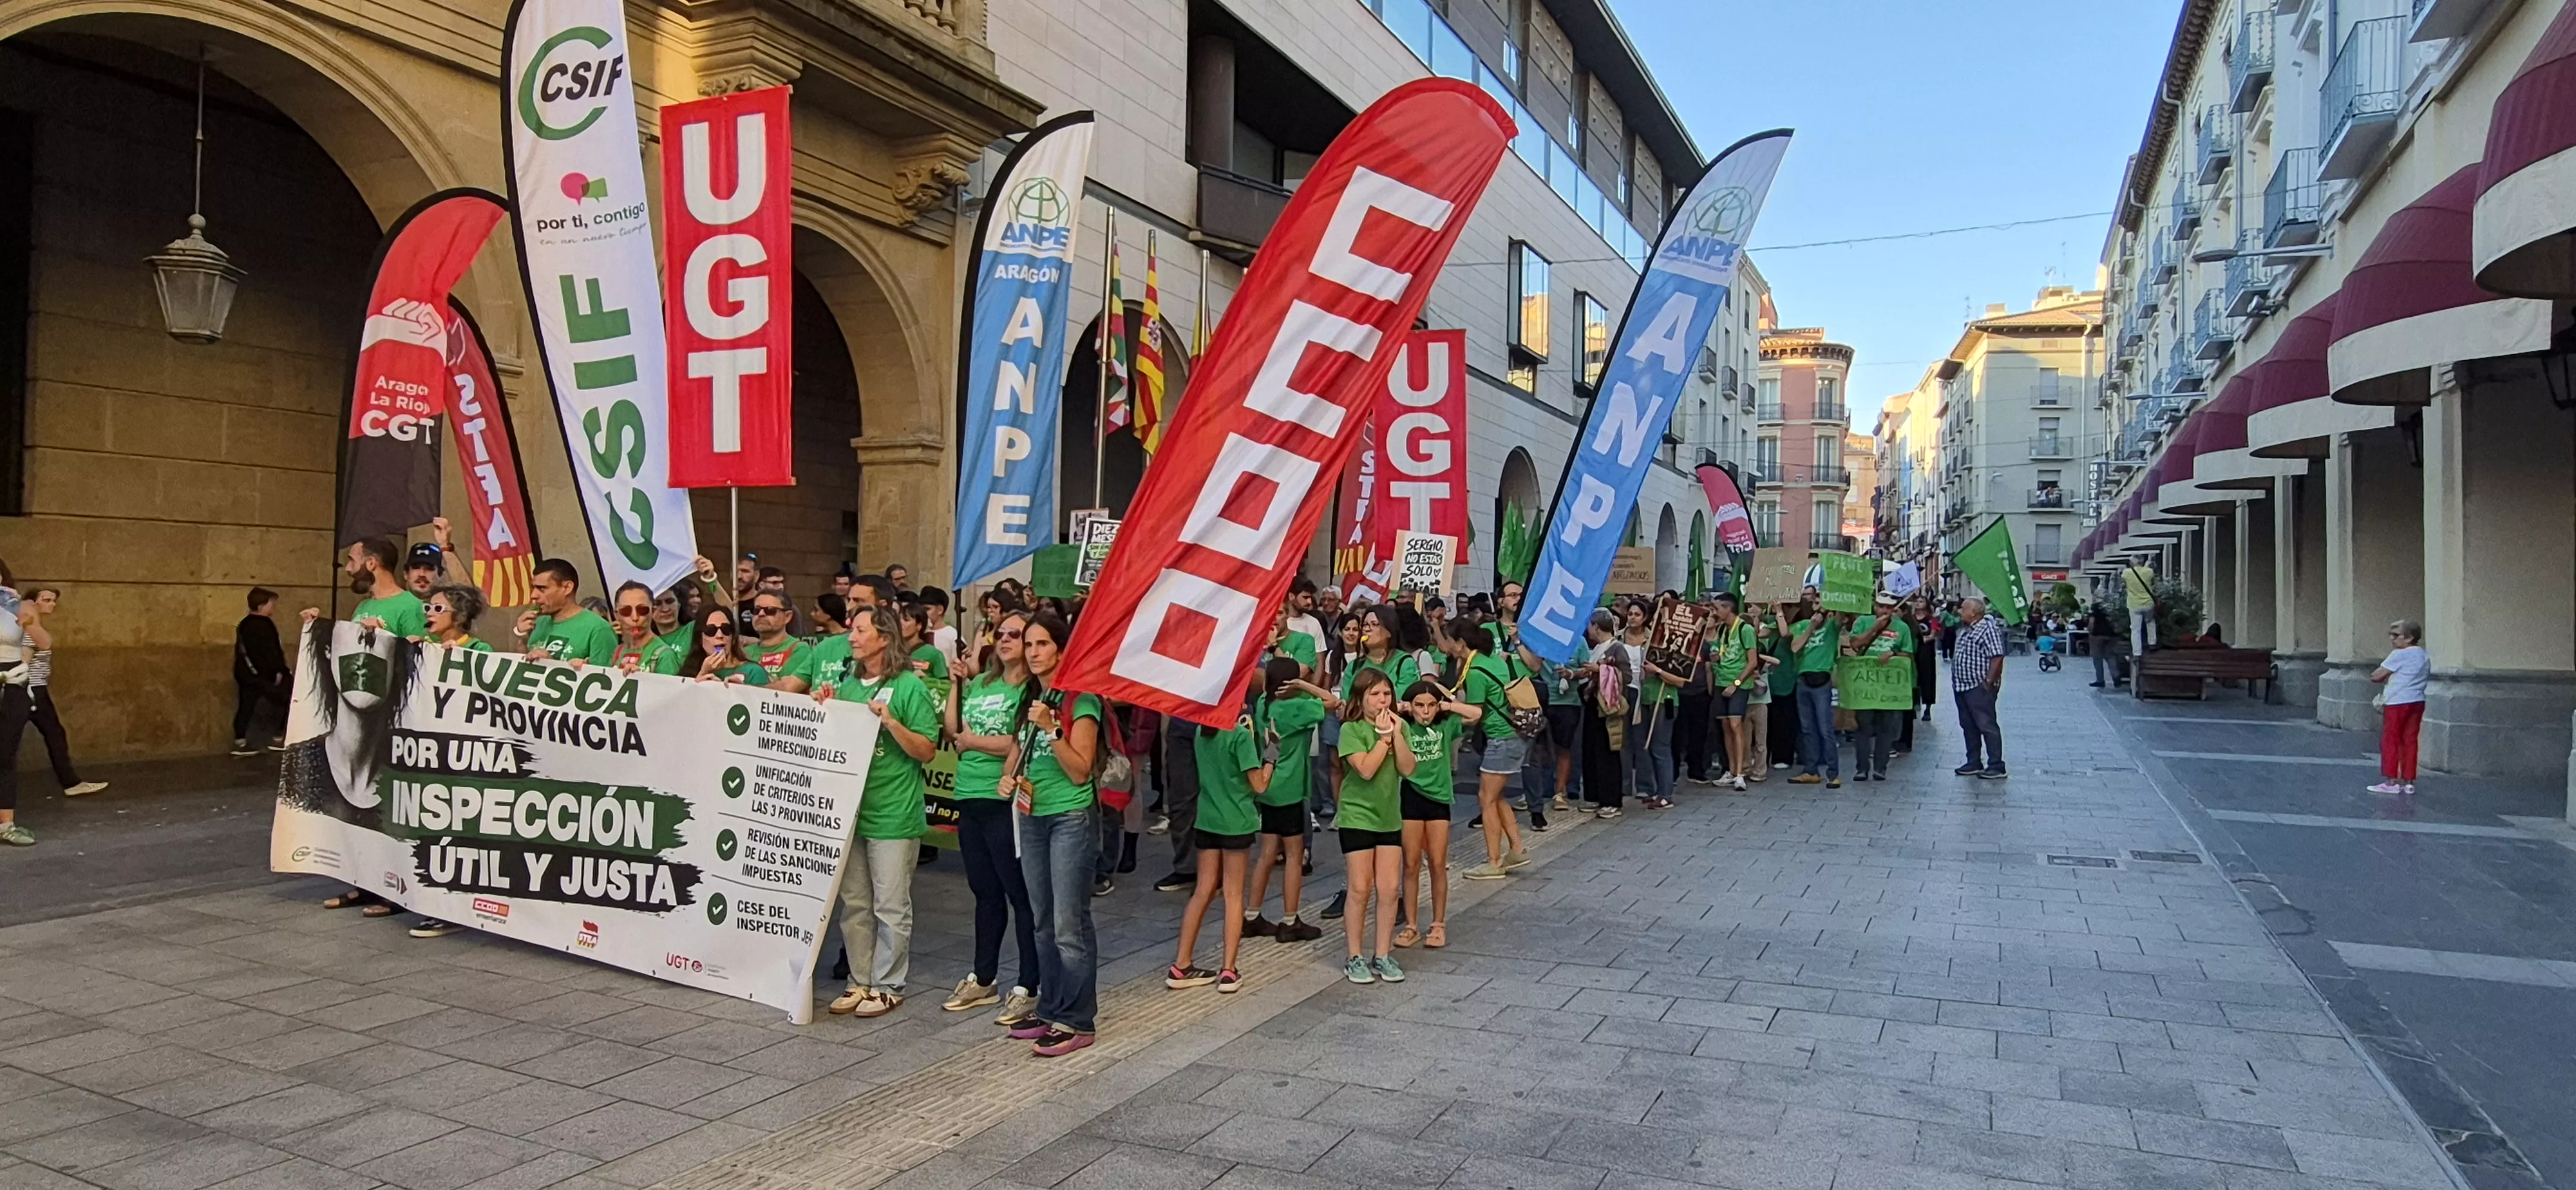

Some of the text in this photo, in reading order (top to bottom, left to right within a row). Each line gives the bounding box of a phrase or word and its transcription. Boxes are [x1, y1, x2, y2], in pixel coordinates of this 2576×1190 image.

[540, 53, 623, 102] CSIF
[536, 202, 645, 232] por ti, contigo
[1000, 222, 1070, 247] ANPE
[681, 112, 770, 453] UGT
[994, 264, 1060, 284] ARAGÓN
[370, 391, 390, 406] La
[361, 410, 435, 444] CGT
[559, 274, 659, 571] CSIF
[985, 298, 1043, 547] ANPE
[1110, 166, 1454, 706] CCOO
[1386, 342, 1450, 534] UGT
[1529, 292, 1697, 646] ANPE
[2088, 464, 2098, 516] HOSTAL
[1093, 523, 1121, 534] DIEZ
[1406, 538, 1444, 552] SERGIO,
[1407, 554, 1417, 563] NO
[1406, 565, 1433, 576] SOLO
[438, 647, 639, 719] HUESCA
[433, 685, 647, 757] Y PROVINCIA
[761, 701, 826, 724] ELIMINACIÓN
[759, 719, 818, 741] DE MÍNIMOS
[392, 735, 517, 773] POR UNA
[758, 736, 847, 764] IMPRESCINDIBLES
[755, 764, 812, 789] UNIFICACIÓN
[753, 782, 834, 811] DE CRITERIOS EN
[392, 779, 655, 849] INSPECCIÓN
[752, 799, 842, 830] LAS 3 PROVINCIAS
[938, 807, 951, 817] no
[744, 845, 756, 860] DE
[758, 849, 777, 865] LAS
[748, 828, 840, 860] REVISIÓN EXTERNA
[430, 837, 677, 906] ÚTIL Y JUSTA
[742, 863, 802, 886] IMPUESTAS
[737, 900, 791, 920] CESE DEL
[737, 917, 800, 940] INSPECTOR
[666, 952, 690, 970] UGT
